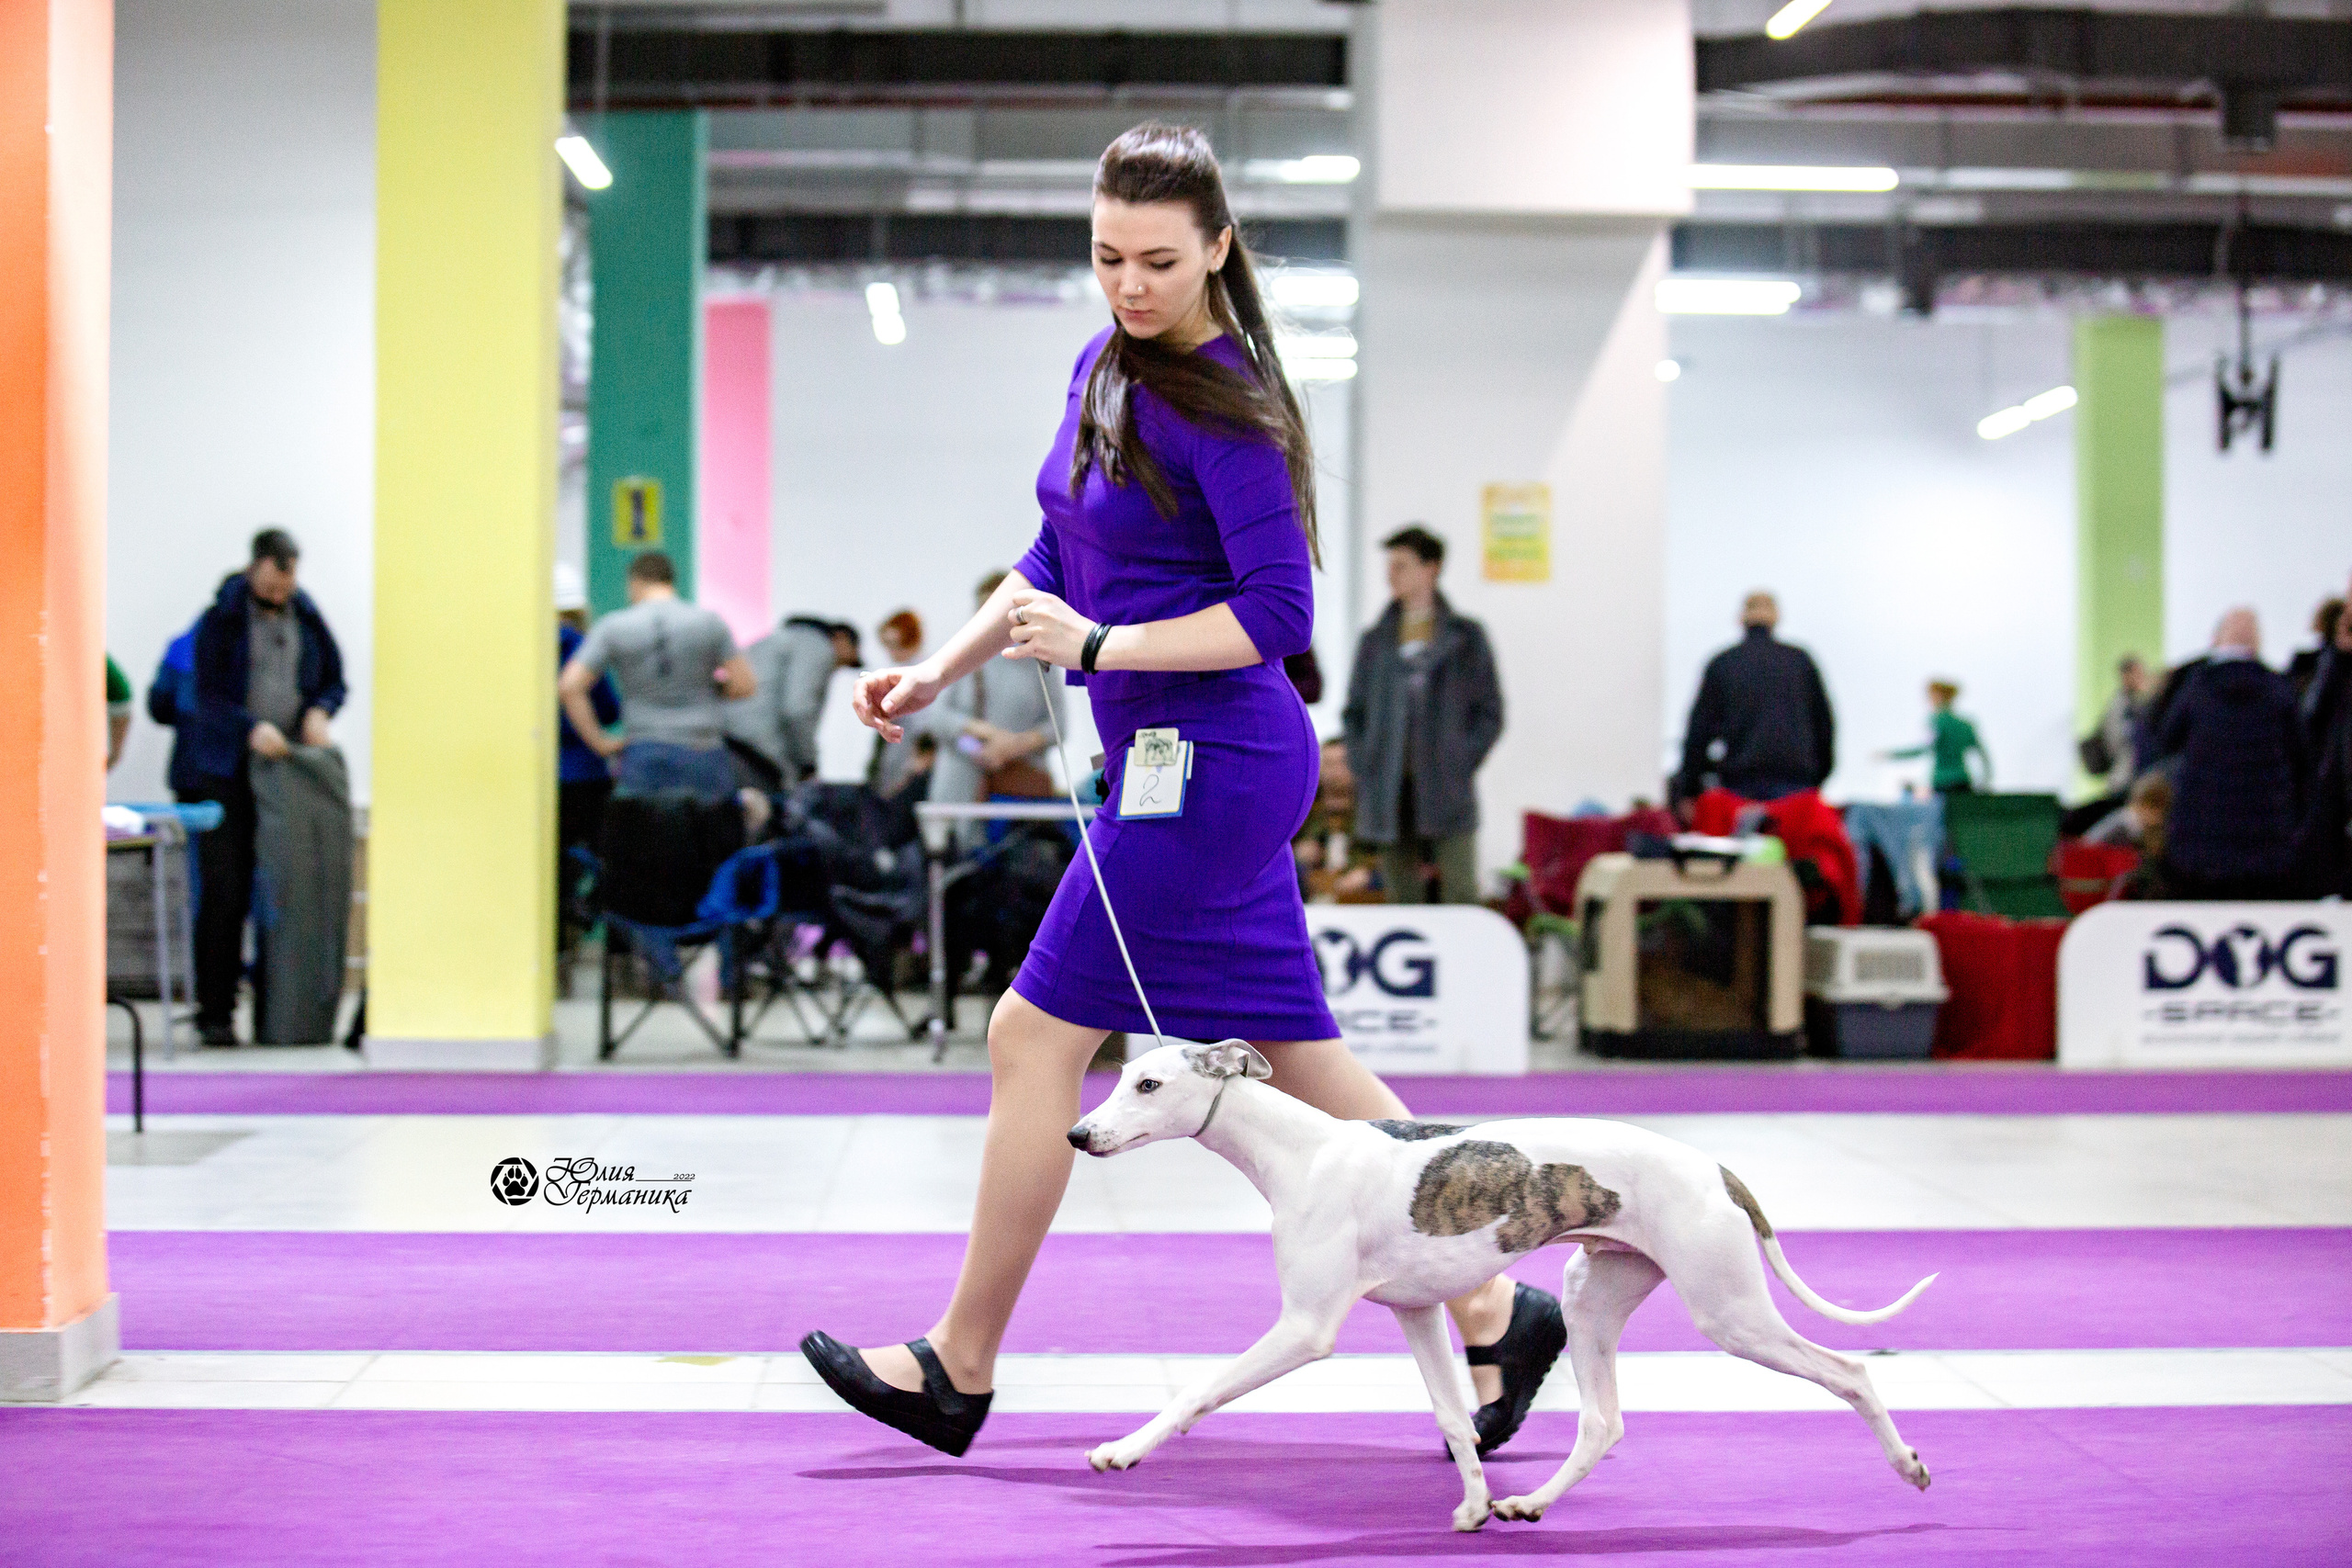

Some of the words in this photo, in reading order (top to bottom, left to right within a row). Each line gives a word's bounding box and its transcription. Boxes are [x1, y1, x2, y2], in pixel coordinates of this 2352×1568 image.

[1139, 773, 1161, 807] 2
[1311, 930, 1436, 997] OG
[2143, 923, 2339, 990] DOG
